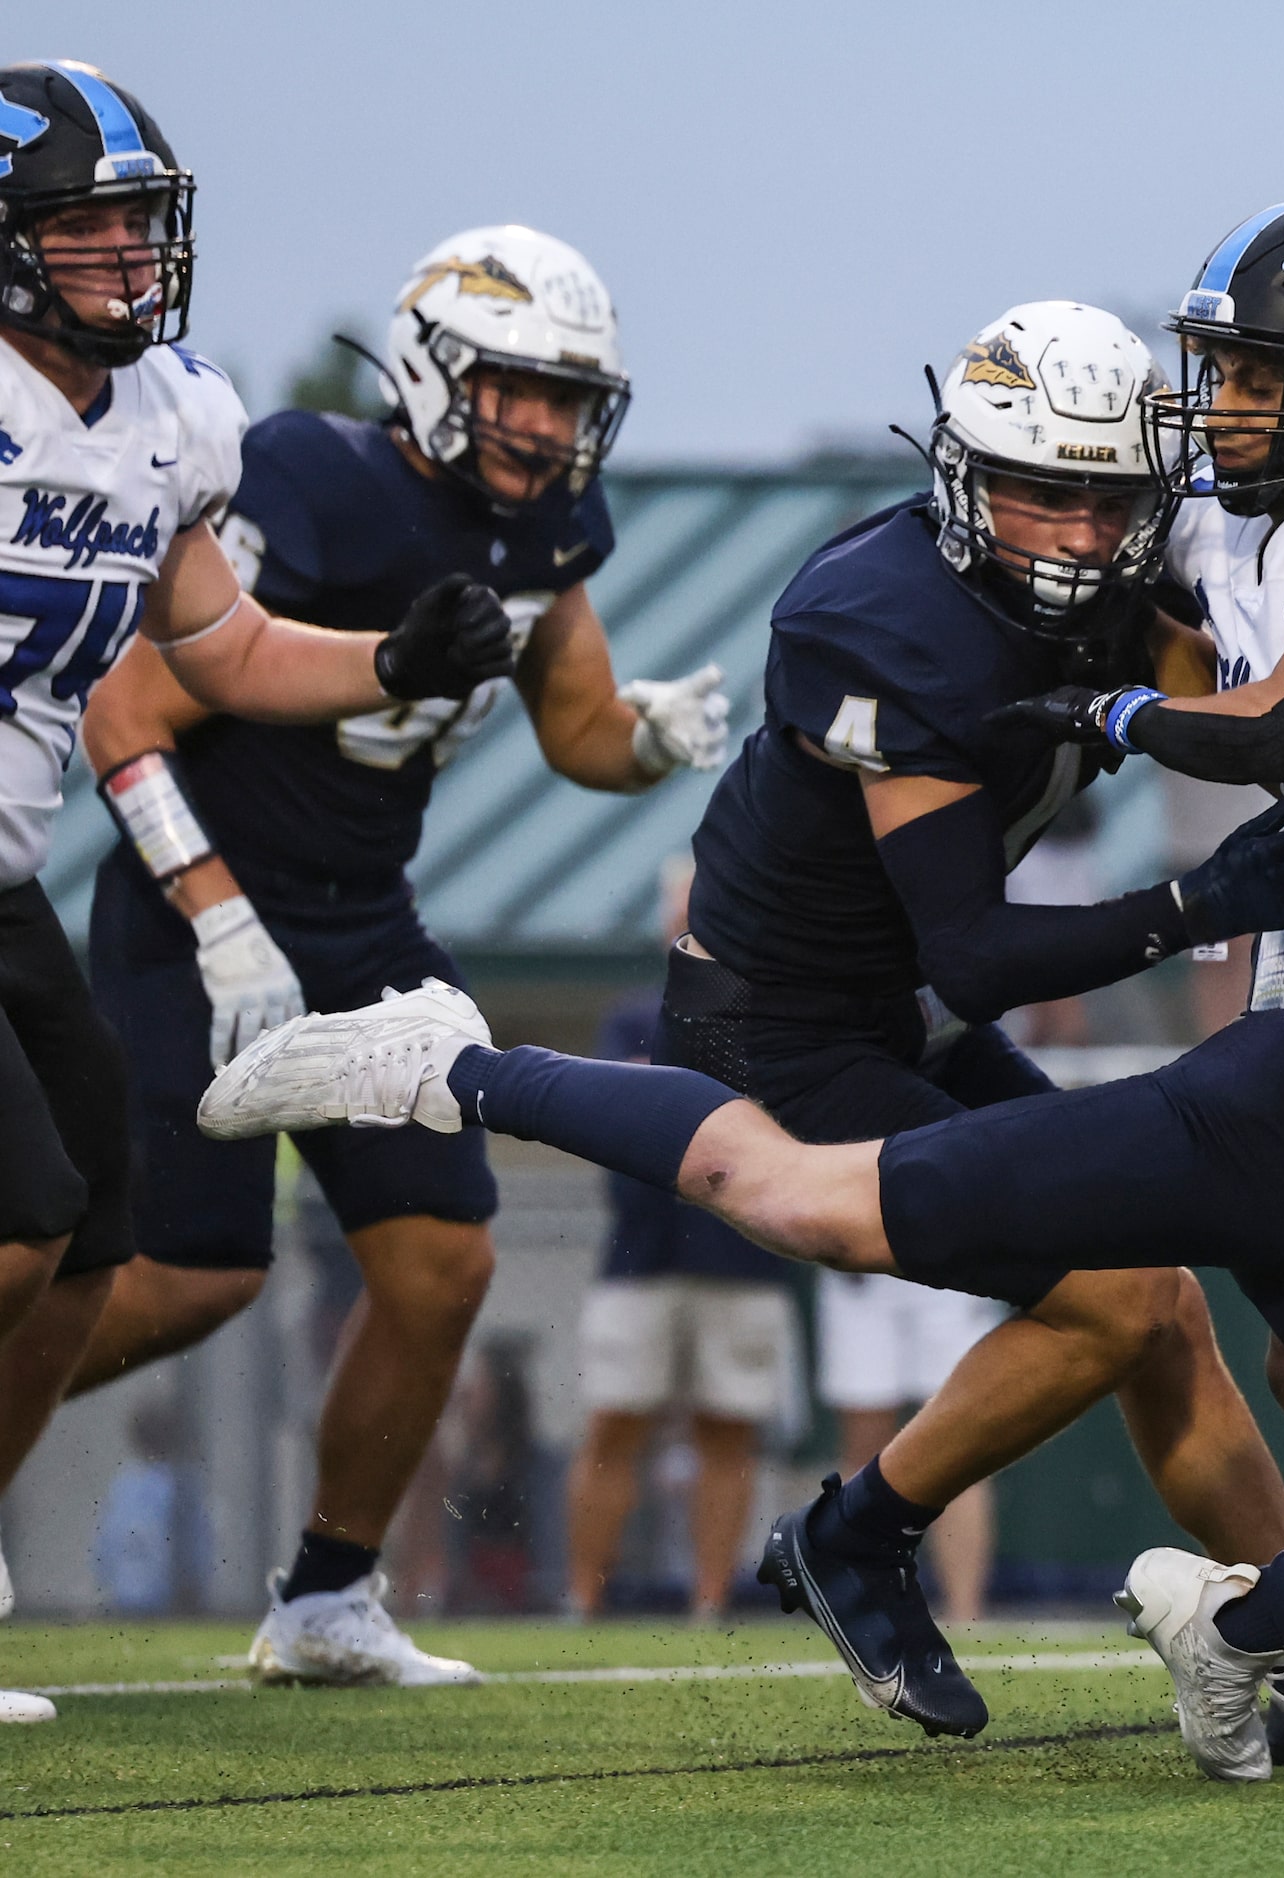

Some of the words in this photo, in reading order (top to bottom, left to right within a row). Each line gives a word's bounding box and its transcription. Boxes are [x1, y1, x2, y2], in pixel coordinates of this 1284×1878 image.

[1057, 442, 1118, 463] KELLER
[10, 487, 159, 570] Wolfpack
[823, 693, 892, 774] 4
